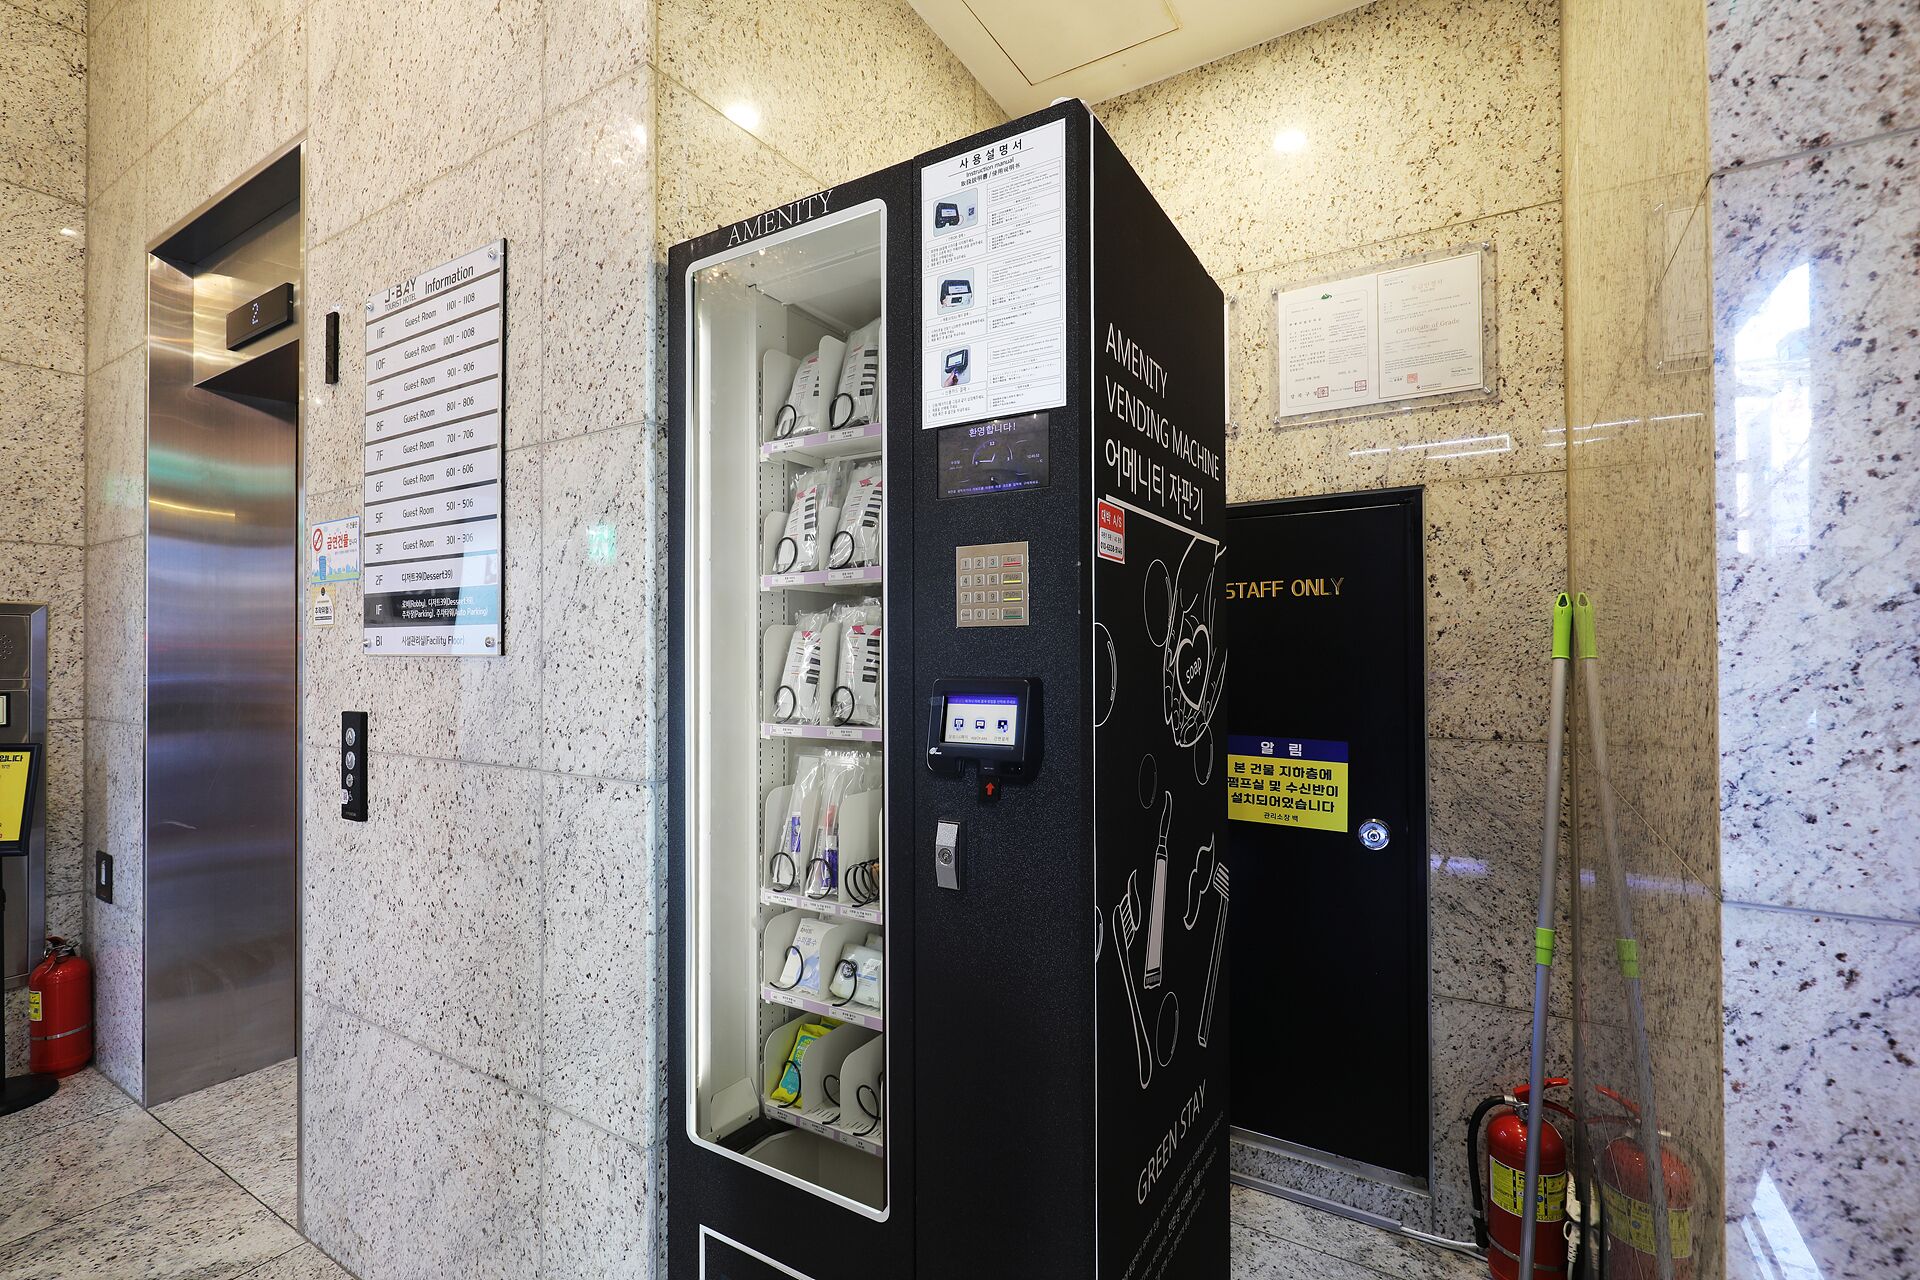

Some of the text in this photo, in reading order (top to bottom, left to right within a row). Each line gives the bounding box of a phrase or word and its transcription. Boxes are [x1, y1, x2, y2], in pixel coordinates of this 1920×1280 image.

[966, 157, 1015, 178] Instruction manual
[727, 190, 833, 247] AMENITY
[384, 265, 474, 303] J-BAY Information
[252, 302, 259, 325] 2
[384, 300, 402, 312] TOURIST
[404, 313, 420, 328] Guest
[421, 310, 437, 321] Room
[446, 300, 456, 311] 1101
[463, 292, 476, 305] 1108
[1396, 324, 1430, 335] Certificate
[404, 346, 420, 360] Guest
[421, 343, 436, 353] Room
[443, 335, 455, 346] 1001
[461, 327, 475, 339] 1008
[1105, 322, 1168, 399] AMENITY
[376, 389, 385, 401] 9F
[403, 379, 419, 392] Guest
[420, 376, 436, 386] Room
[446, 368, 457, 378] 901
[463, 361, 475, 373] 906
[376, 420, 384, 432] 8F
[403, 412, 419, 424] Guest
[420, 409, 435, 419] Room
[446, 402, 456, 412] 801
[462, 396, 474, 407] 806
[968, 421, 1016, 437] 환영합니다!
[1105, 375, 1169, 450] VENDING
[1172, 424, 1220, 482] MACHINE
[376, 450, 384, 461] 7F
[402, 443, 418, 454] Guest
[419, 439, 435, 449] Room
[446, 433, 456, 444] 701
[463, 428, 474, 439] 706
[375, 481, 383, 493] 6F
[402, 475, 418, 486] Guest
[419, 473, 435, 482] Room
[445, 467, 456, 478] 601
[462, 463, 474, 474] 606
[1105, 438, 1204, 525] 어메니티 자판기
[375, 512, 383, 524] 5F
[402, 508, 418, 518] Guest
[419, 506, 435, 515] Room
[446, 501, 456, 511] 501
[462, 498, 474, 509] 506
[375, 543, 383, 555] 3F
[402, 540, 418, 551] Guest
[419, 539, 435, 548] Room
[446, 535, 456, 545] 301
[462, 533, 474, 544] 306
[375, 574, 383, 585] 2F
[1226, 577, 1344, 599] STAFF ONLY
[1233, 761, 1332, 781] 본 건물 지하층에
[1227, 776, 1339, 798] 펌프실 및 수신반이
[1231, 792, 1335, 814] 설치되어있습니다
[1263, 811, 1290, 821] 관리소장
[1137, 1121, 1178, 1205] GREEN
[1180, 1079, 1207, 1139] STAY
